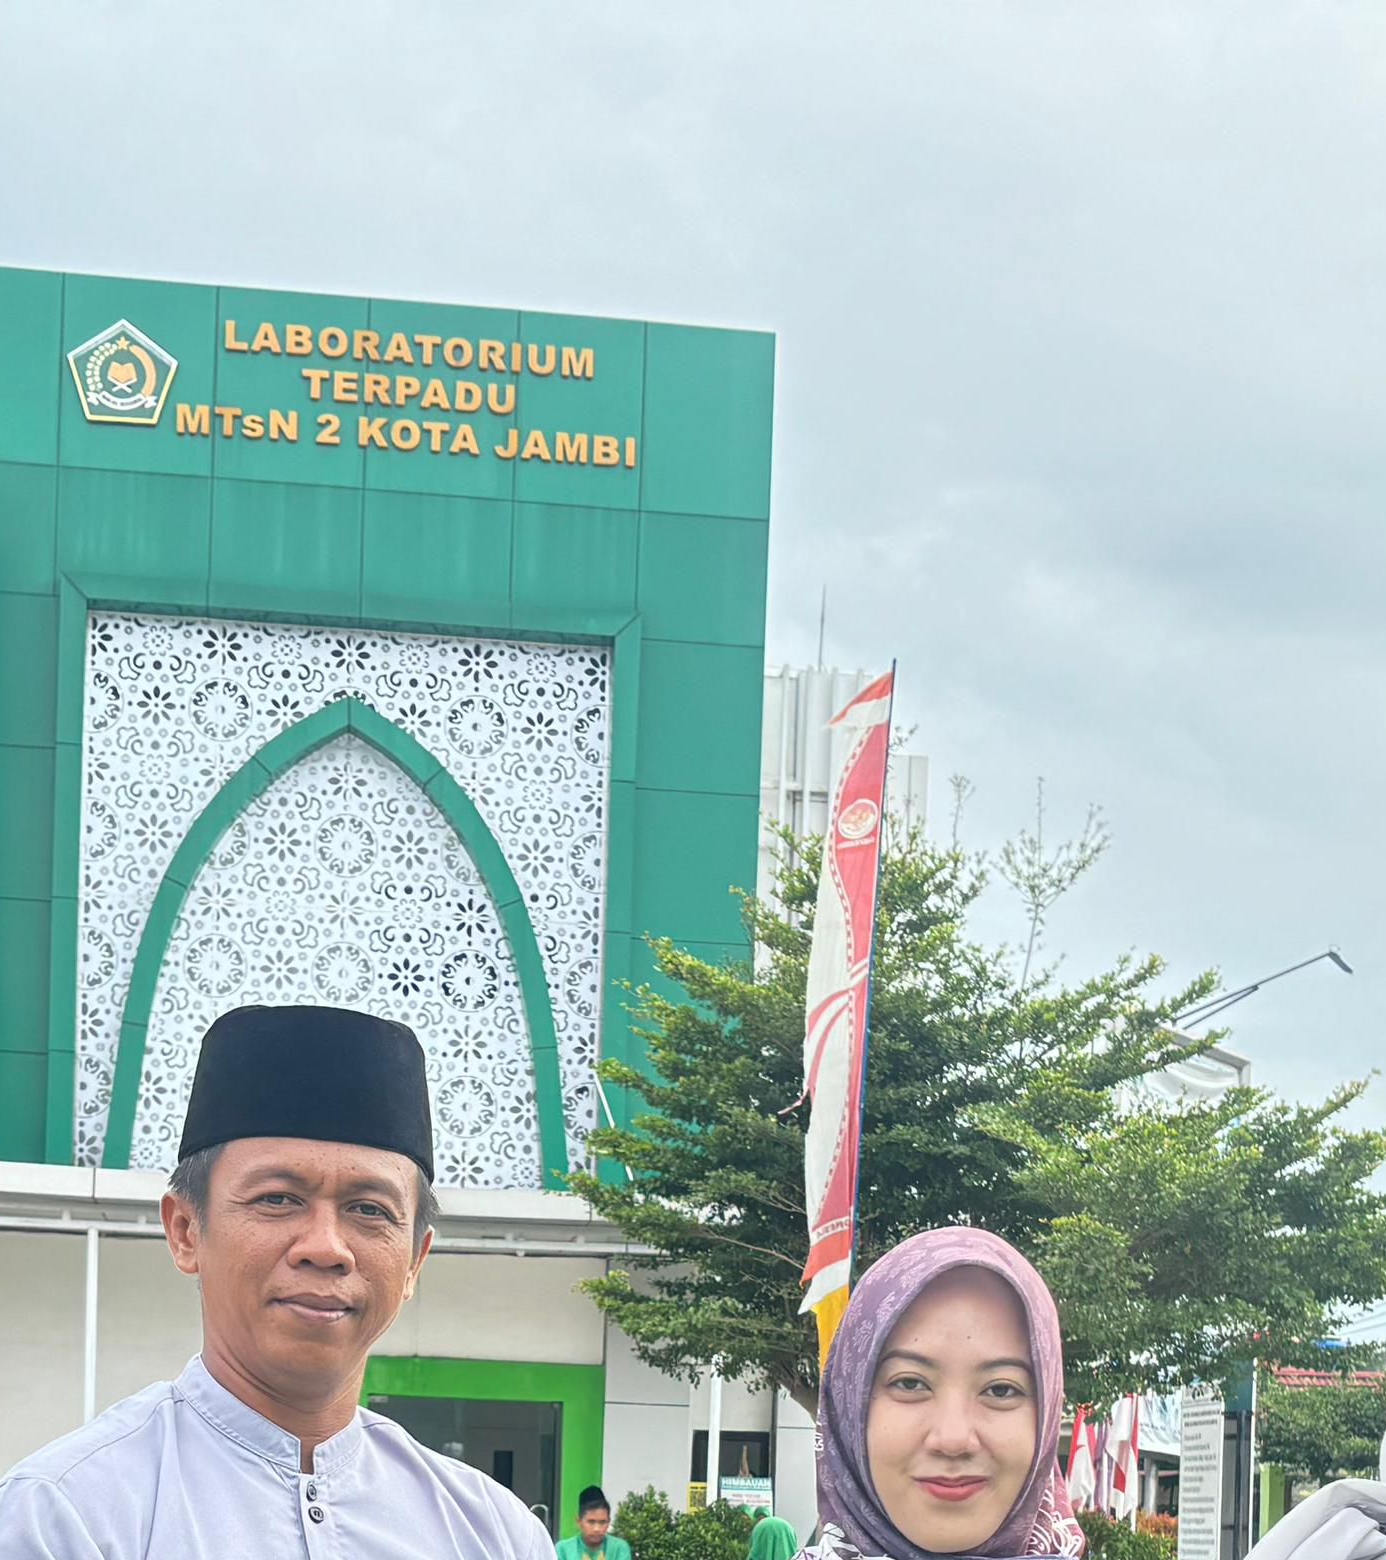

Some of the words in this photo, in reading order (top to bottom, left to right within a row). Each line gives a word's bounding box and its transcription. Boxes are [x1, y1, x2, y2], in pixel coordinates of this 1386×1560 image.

[223, 319, 594, 379] LABORATORIUM
[301, 368, 515, 414] TERPADU
[175, 403, 299, 441] MTsN
[316, 413, 341, 445] 2
[358, 417, 480, 456] KOTA
[494, 428, 637, 468] JAMBI
